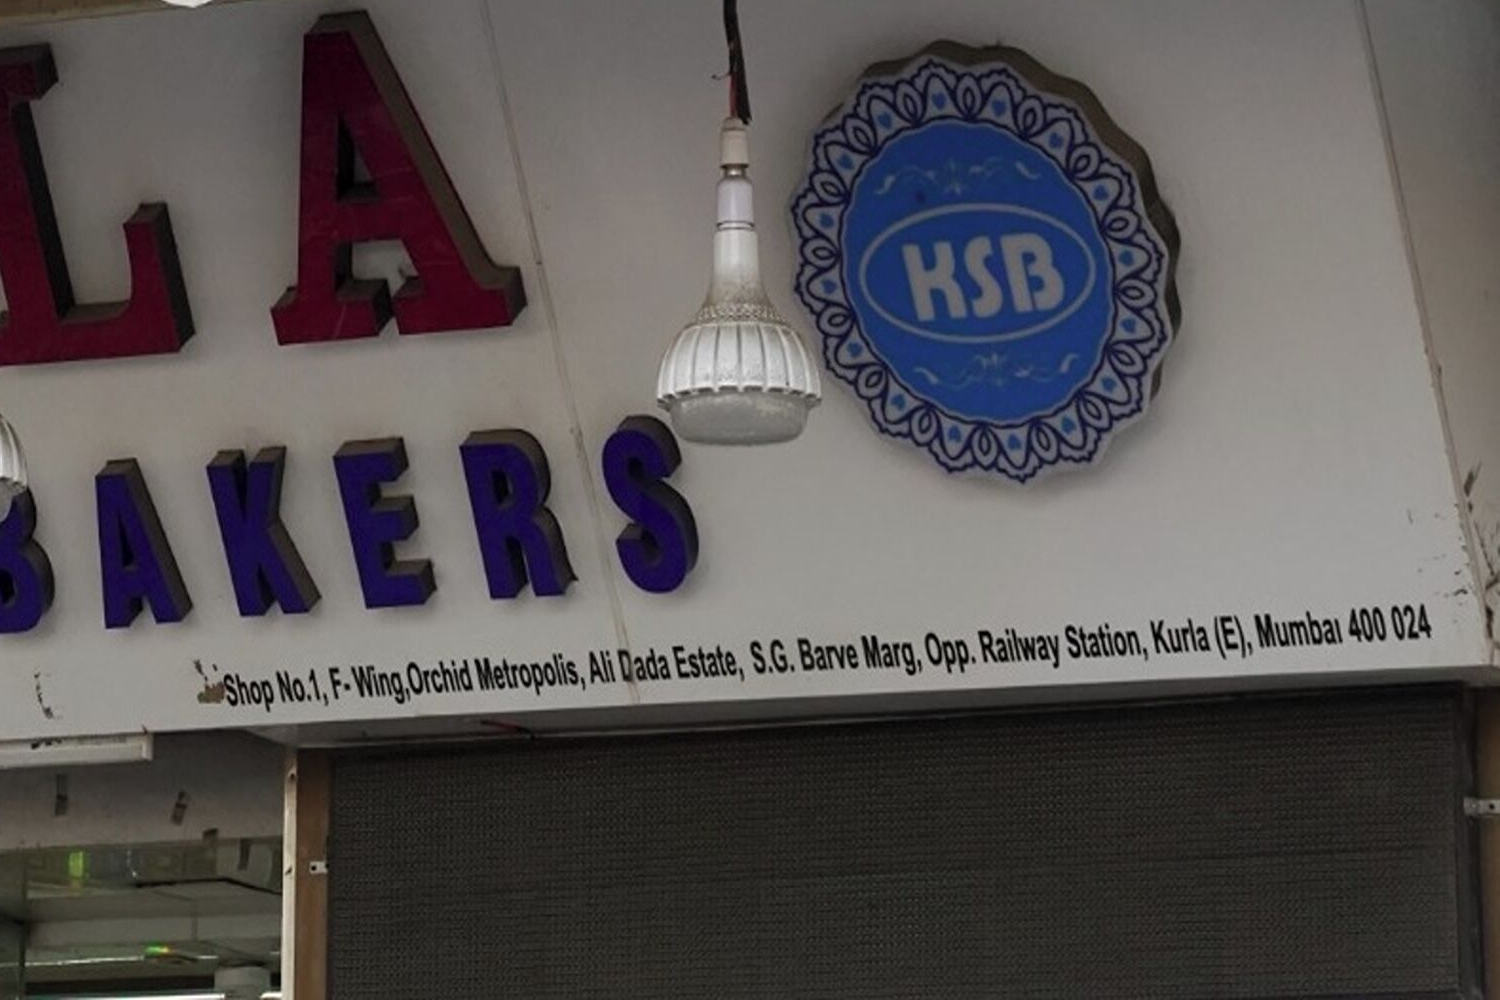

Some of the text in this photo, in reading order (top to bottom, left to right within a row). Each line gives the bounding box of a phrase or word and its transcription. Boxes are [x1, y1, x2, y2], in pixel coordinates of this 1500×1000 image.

[902, 232, 1065, 322] KSB
[223, 674, 274, 712] Shop
[276, 668, 329, 706] No.1,
[474, 650, 586, 695] Metropolis,
[588, 649, 617, 684] Ali
[617, 648, 672, 683] Dada
[672, 645, 745, 682] Estate,
[750, 639, 796, 674] S.G.
[797, 637, 859, 671] Barve
[861, 635, 923, 676] Marg,
[924, 632, 976, 674] Opp.
[977, 628, 1059, 669] Railway
[1064, 623, 1149, 662] Station,
[1150, 618, 1211, 654] Kurla
[1213, 614, 1254, 660] (E),
[1254, 611, 1343, 648] Mumbai
[1348, 606, 1387, 643] 400
[1391, 604, 1432, 640] 024
